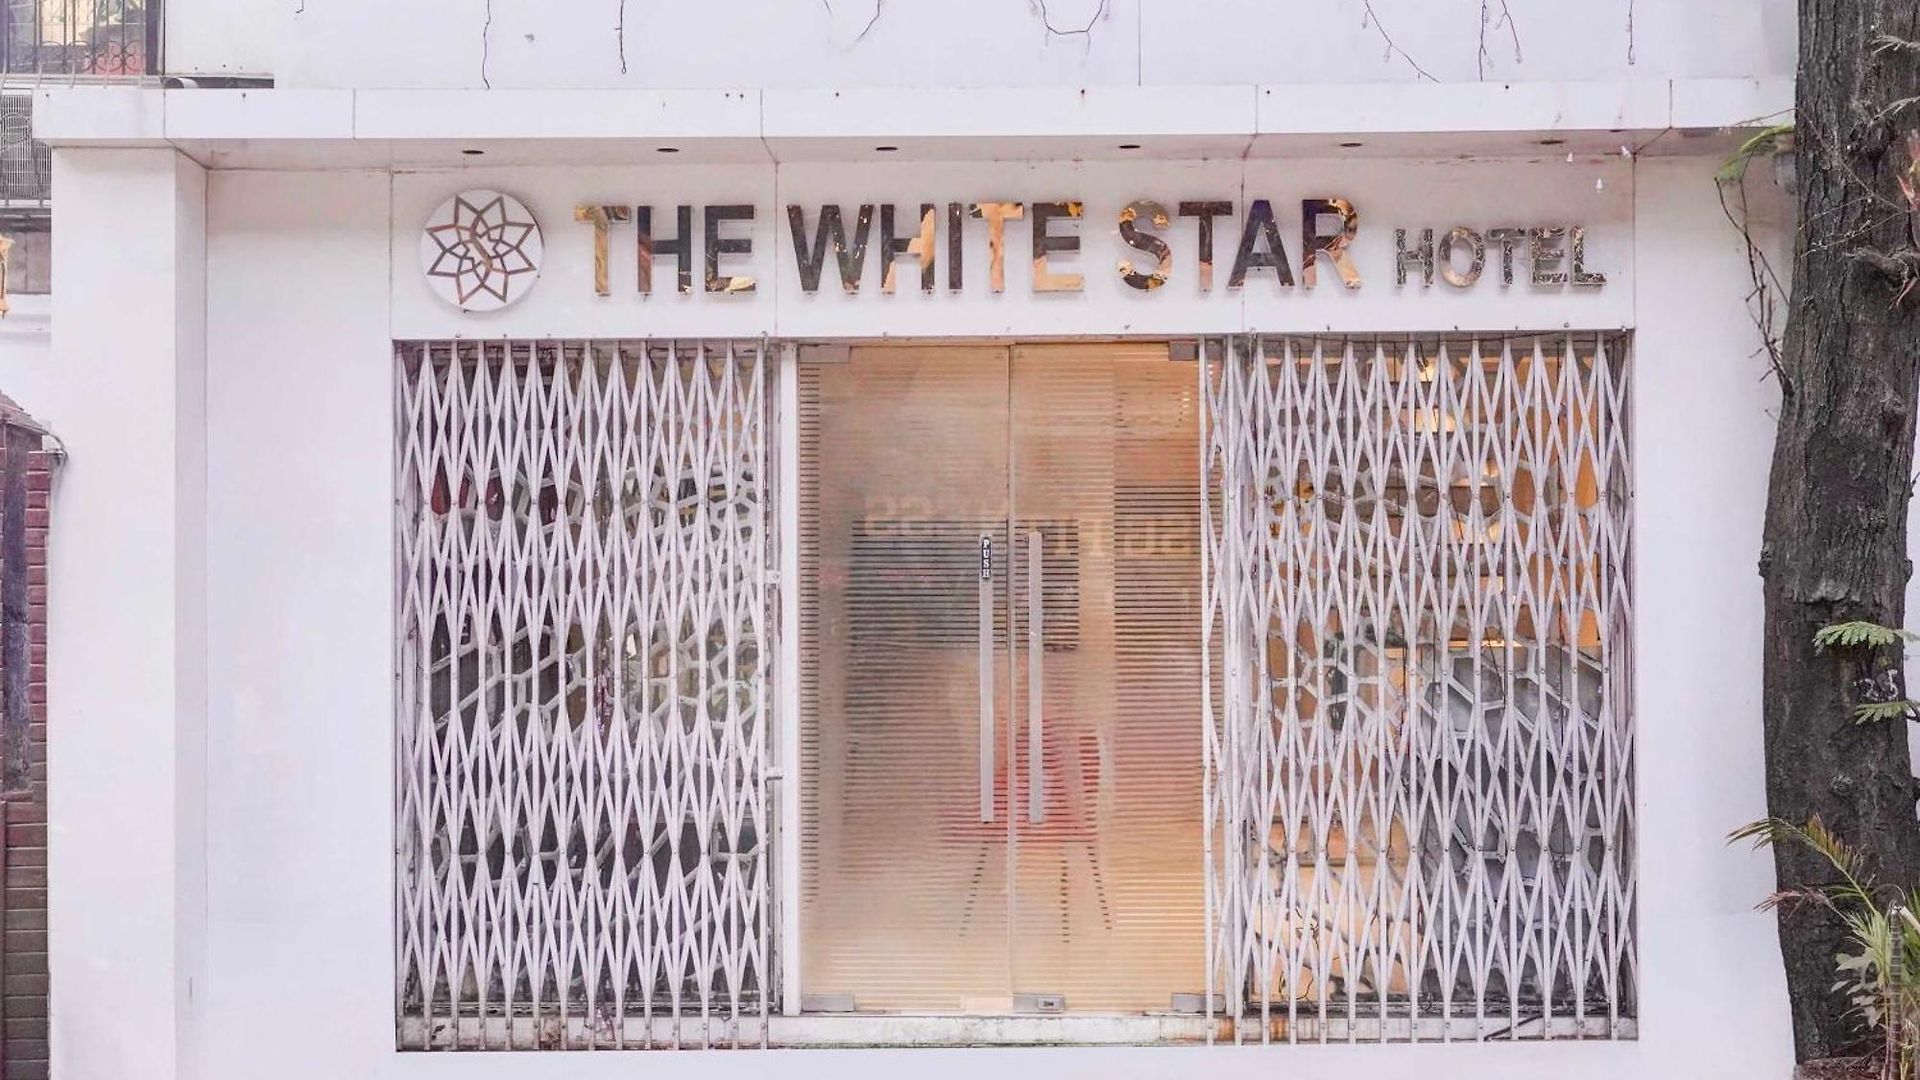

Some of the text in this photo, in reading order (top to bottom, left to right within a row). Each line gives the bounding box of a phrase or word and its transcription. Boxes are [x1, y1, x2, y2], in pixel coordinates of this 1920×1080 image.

[574, 199, 1607, 294] THE WHITE STAR HOTEL
[982, 538, 991, 578] PUSH
